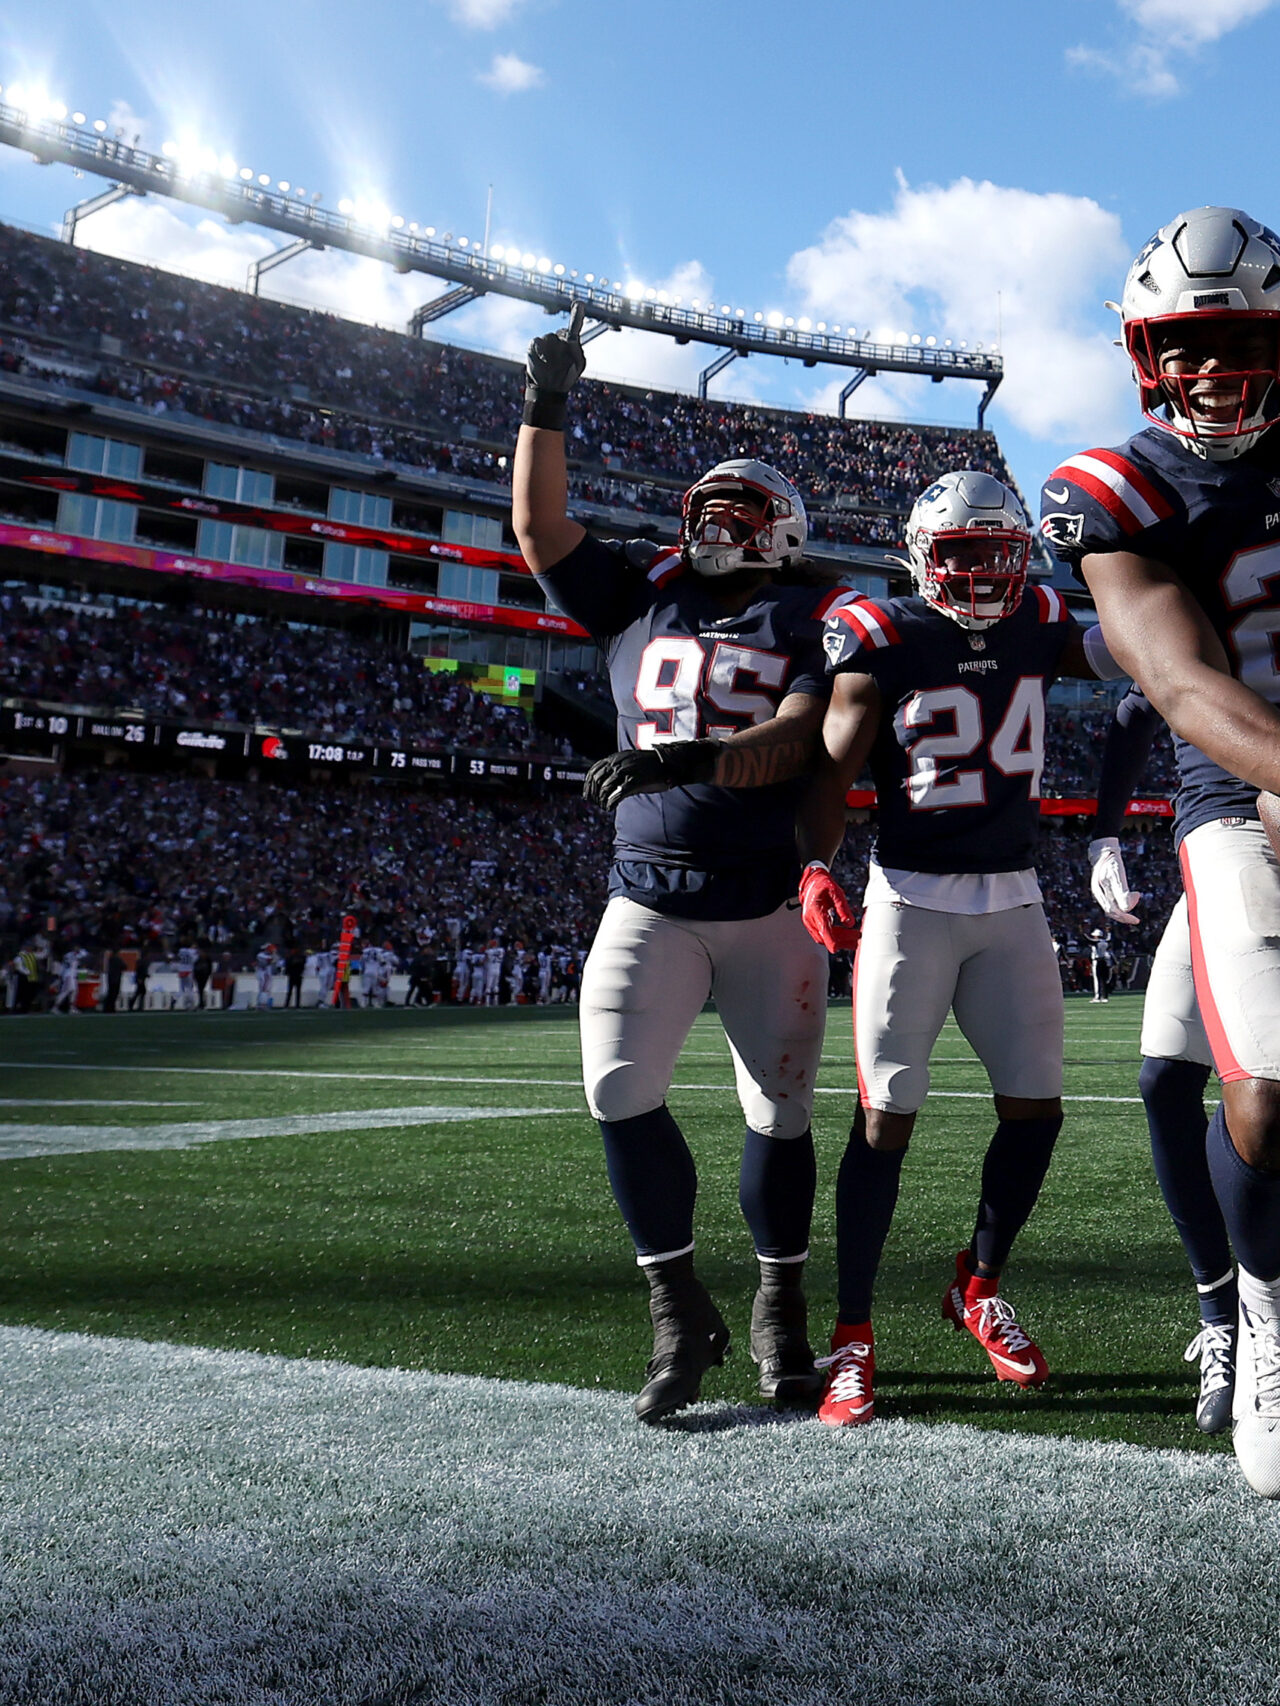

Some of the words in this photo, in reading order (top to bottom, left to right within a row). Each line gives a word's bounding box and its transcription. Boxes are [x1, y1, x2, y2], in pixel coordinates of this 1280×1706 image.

[957, 659, 998, 677] PATRIOTS
[634, 635, 791, 751] 95
[48, 716, 68, 735] 10
[124, 724, 145, 743] 26
[176, 731, 226, 750] Gillette
[903, 675, 1050, 812] 24
[308, 743, 343, 762] 17:08
[390, 752, 406, 768] 75
[469, 759, 485, 775] 53
[543, 766, 552, 781] 6
